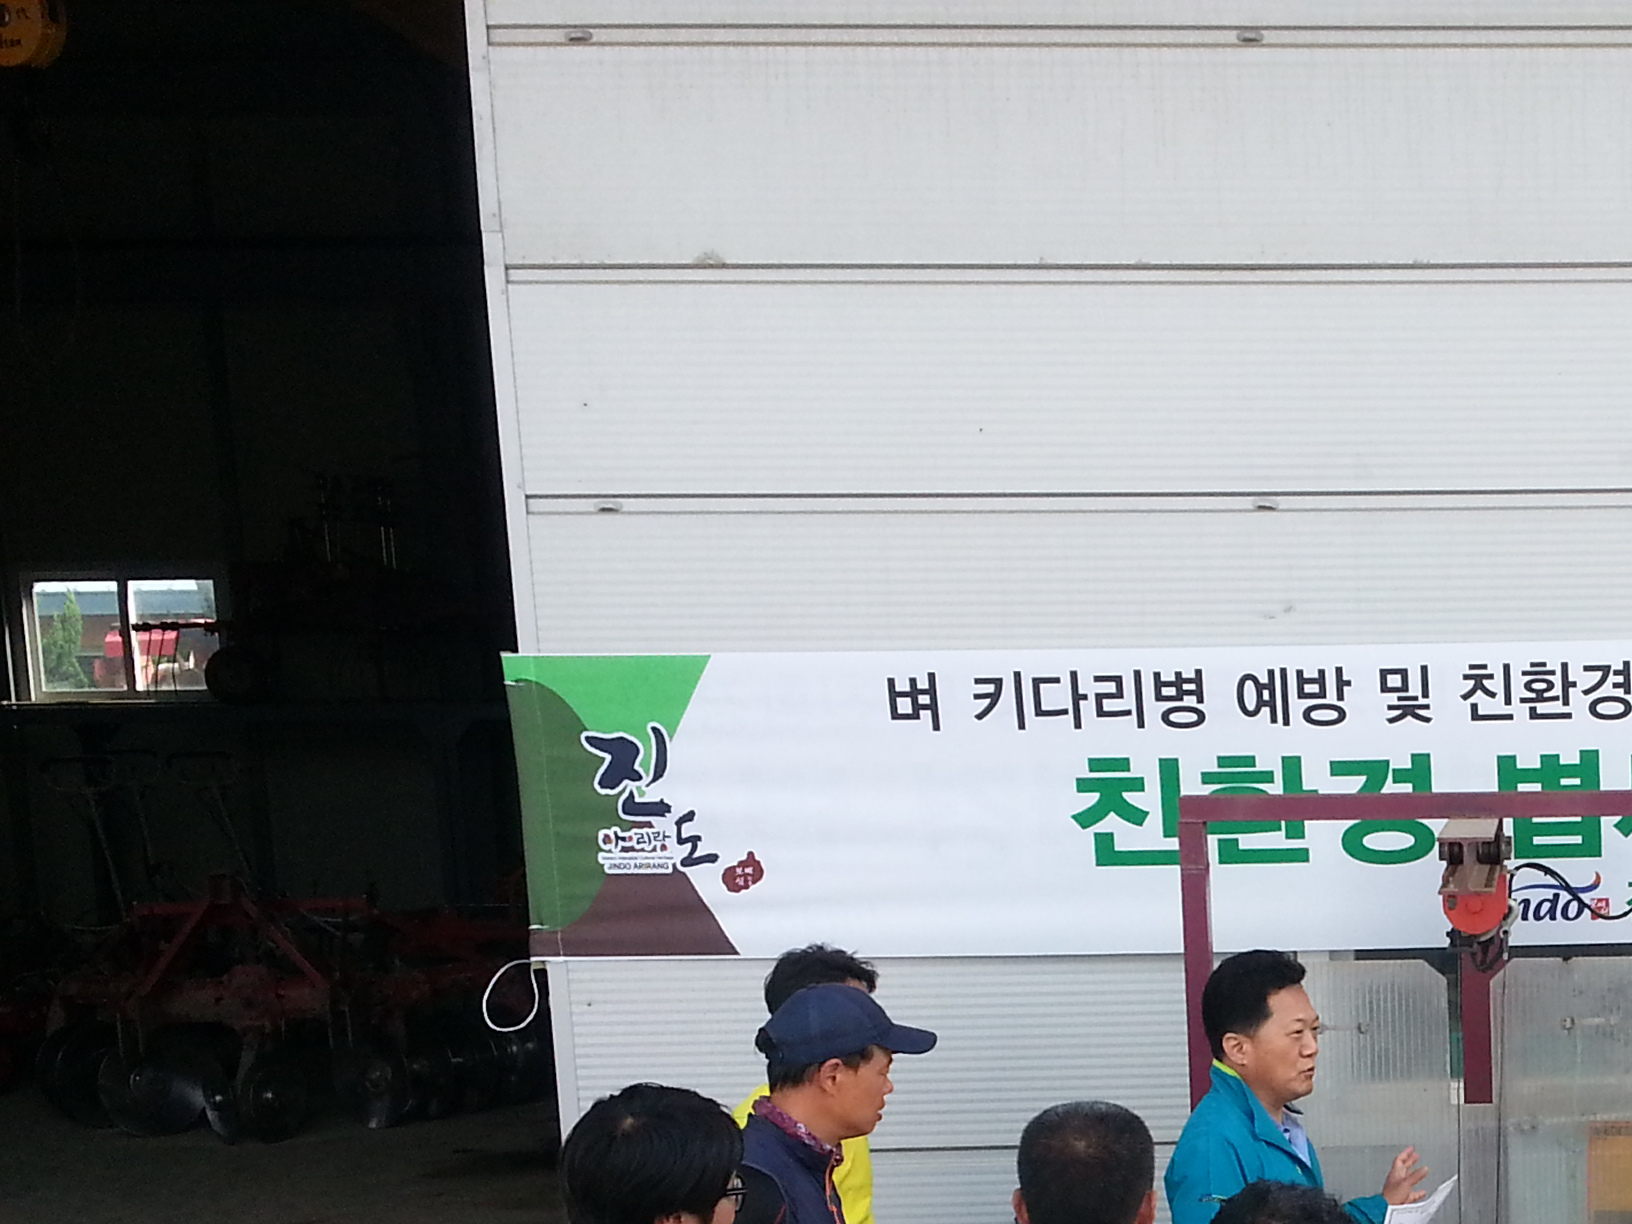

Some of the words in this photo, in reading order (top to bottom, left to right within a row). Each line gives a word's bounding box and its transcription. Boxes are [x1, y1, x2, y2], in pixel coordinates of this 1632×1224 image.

[887, 672, 940, 731] 벼
[974, 669, 1205, 730] 키다리병
[1237, 667, 1351, 726] 예방
[1380, 665, 1432, 723] 및
[1461, 661, 1632, 721] 친환경
[607, 862, 632, 871] JINDO
[633, 861, 670, 871] ARIRANG
